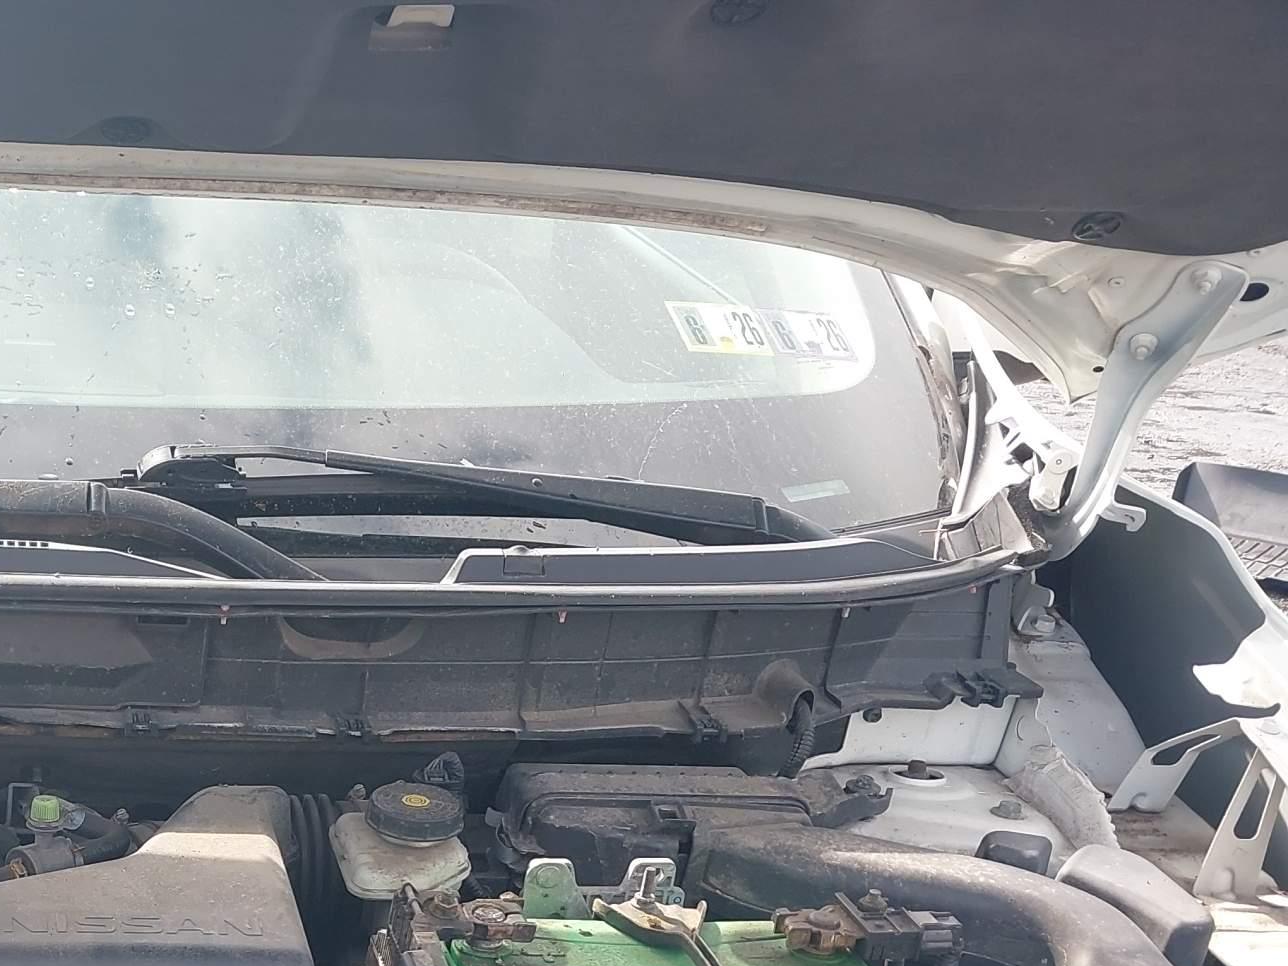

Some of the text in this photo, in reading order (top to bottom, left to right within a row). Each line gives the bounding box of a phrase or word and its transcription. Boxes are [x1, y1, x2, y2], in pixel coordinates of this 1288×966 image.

[685, 311, 765, 346] 6 26
[817, 318, 849, 352] 26
[1, 916, 263, 937] NISSAN
